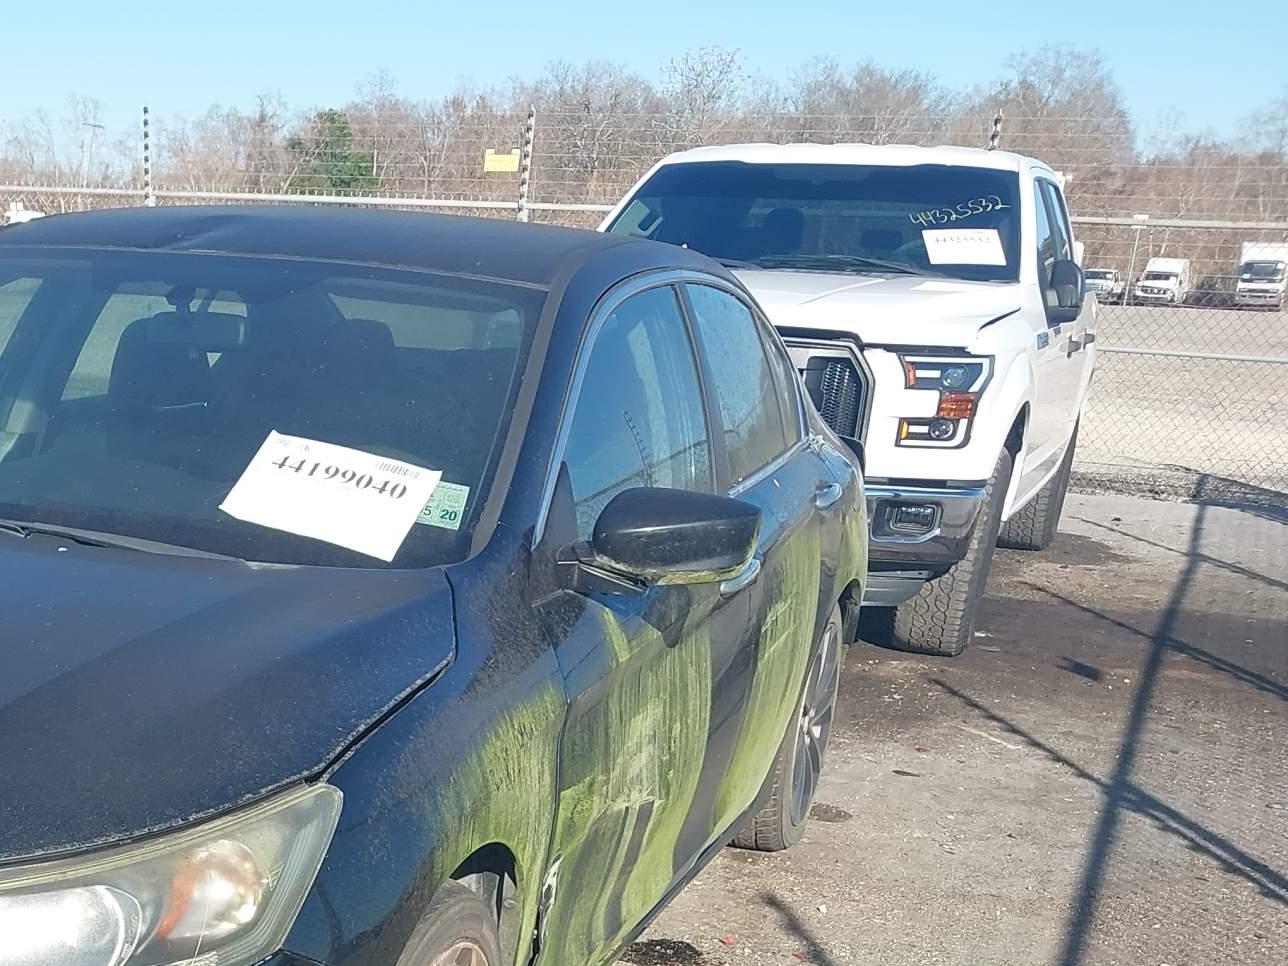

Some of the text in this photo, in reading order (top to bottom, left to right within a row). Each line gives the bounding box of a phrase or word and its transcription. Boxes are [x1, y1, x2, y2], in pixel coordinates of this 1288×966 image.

[909, 195, 1011, 226] 44325532
[272, 455, 408, 500] 44199040
[439, 509, 458, 521] 20
